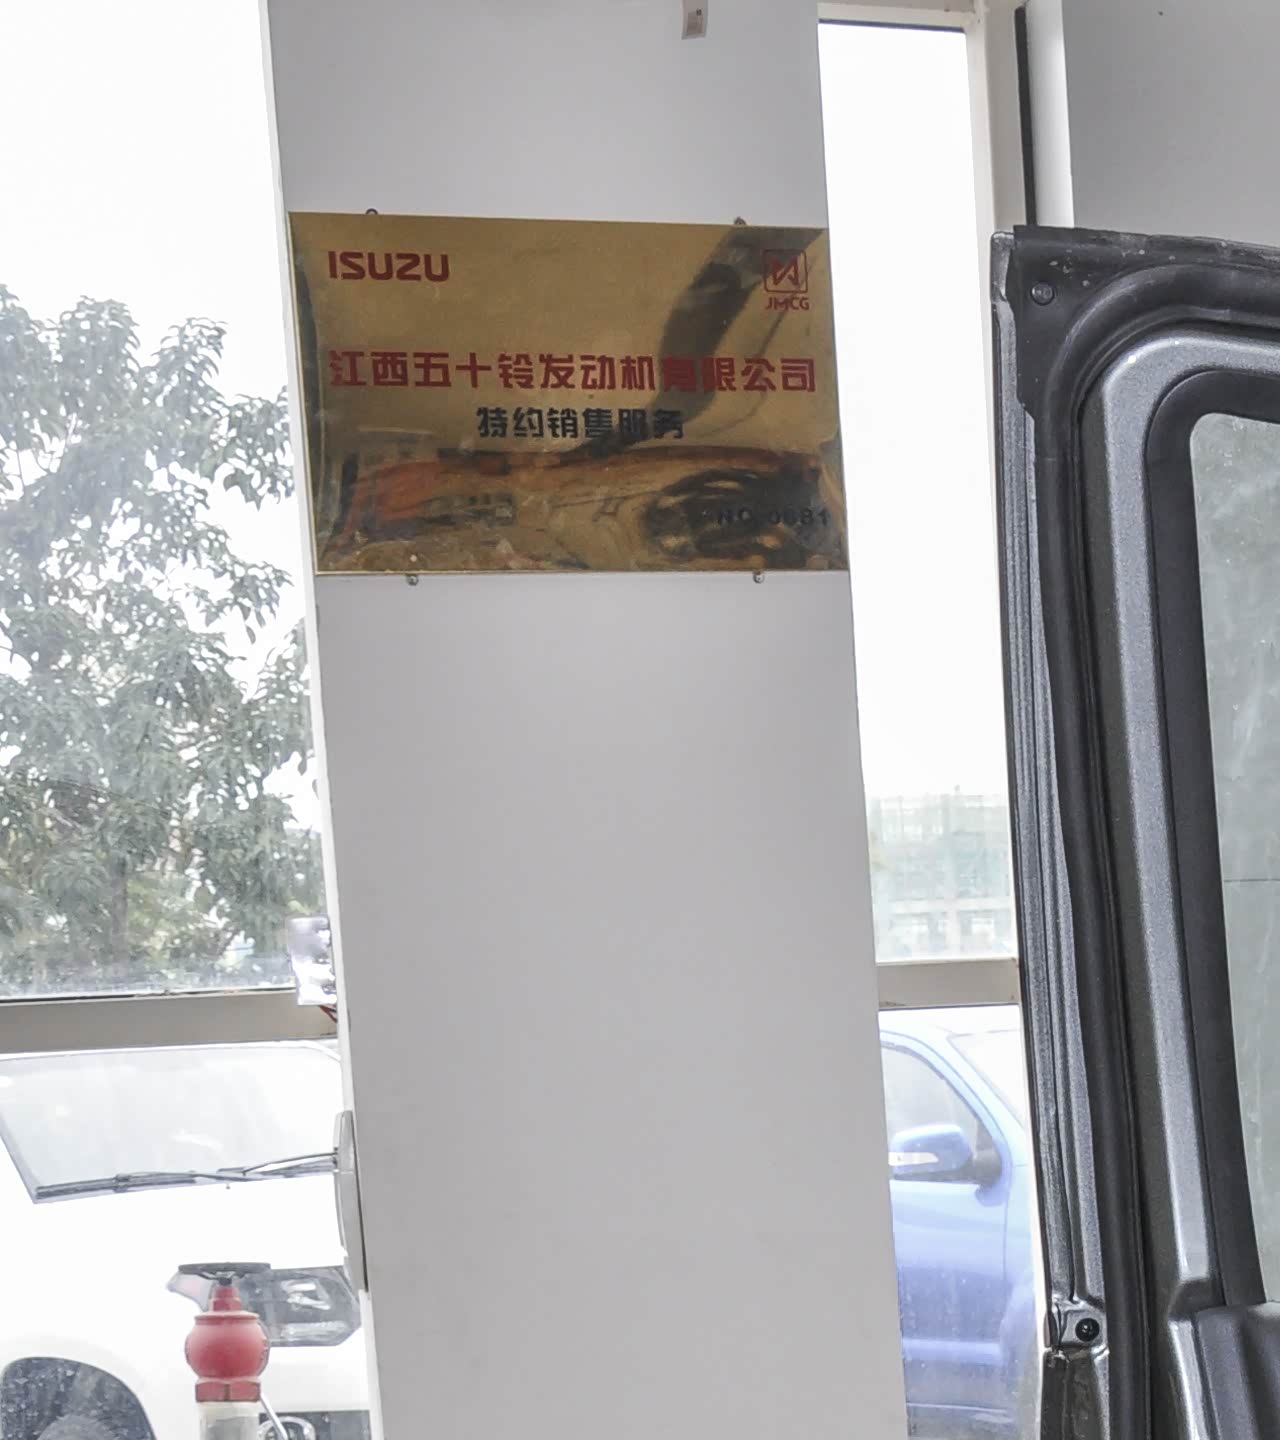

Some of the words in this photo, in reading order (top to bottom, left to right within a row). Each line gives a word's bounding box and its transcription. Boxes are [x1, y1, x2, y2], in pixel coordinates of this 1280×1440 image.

[327, 250, 451, 283] ISUZU
[764, 295, 811, 311] JMCG
[328, 349, 817, 393] 江西五十铃发动机有限公司
[476, 405, 685, 440] 特约销售服务
